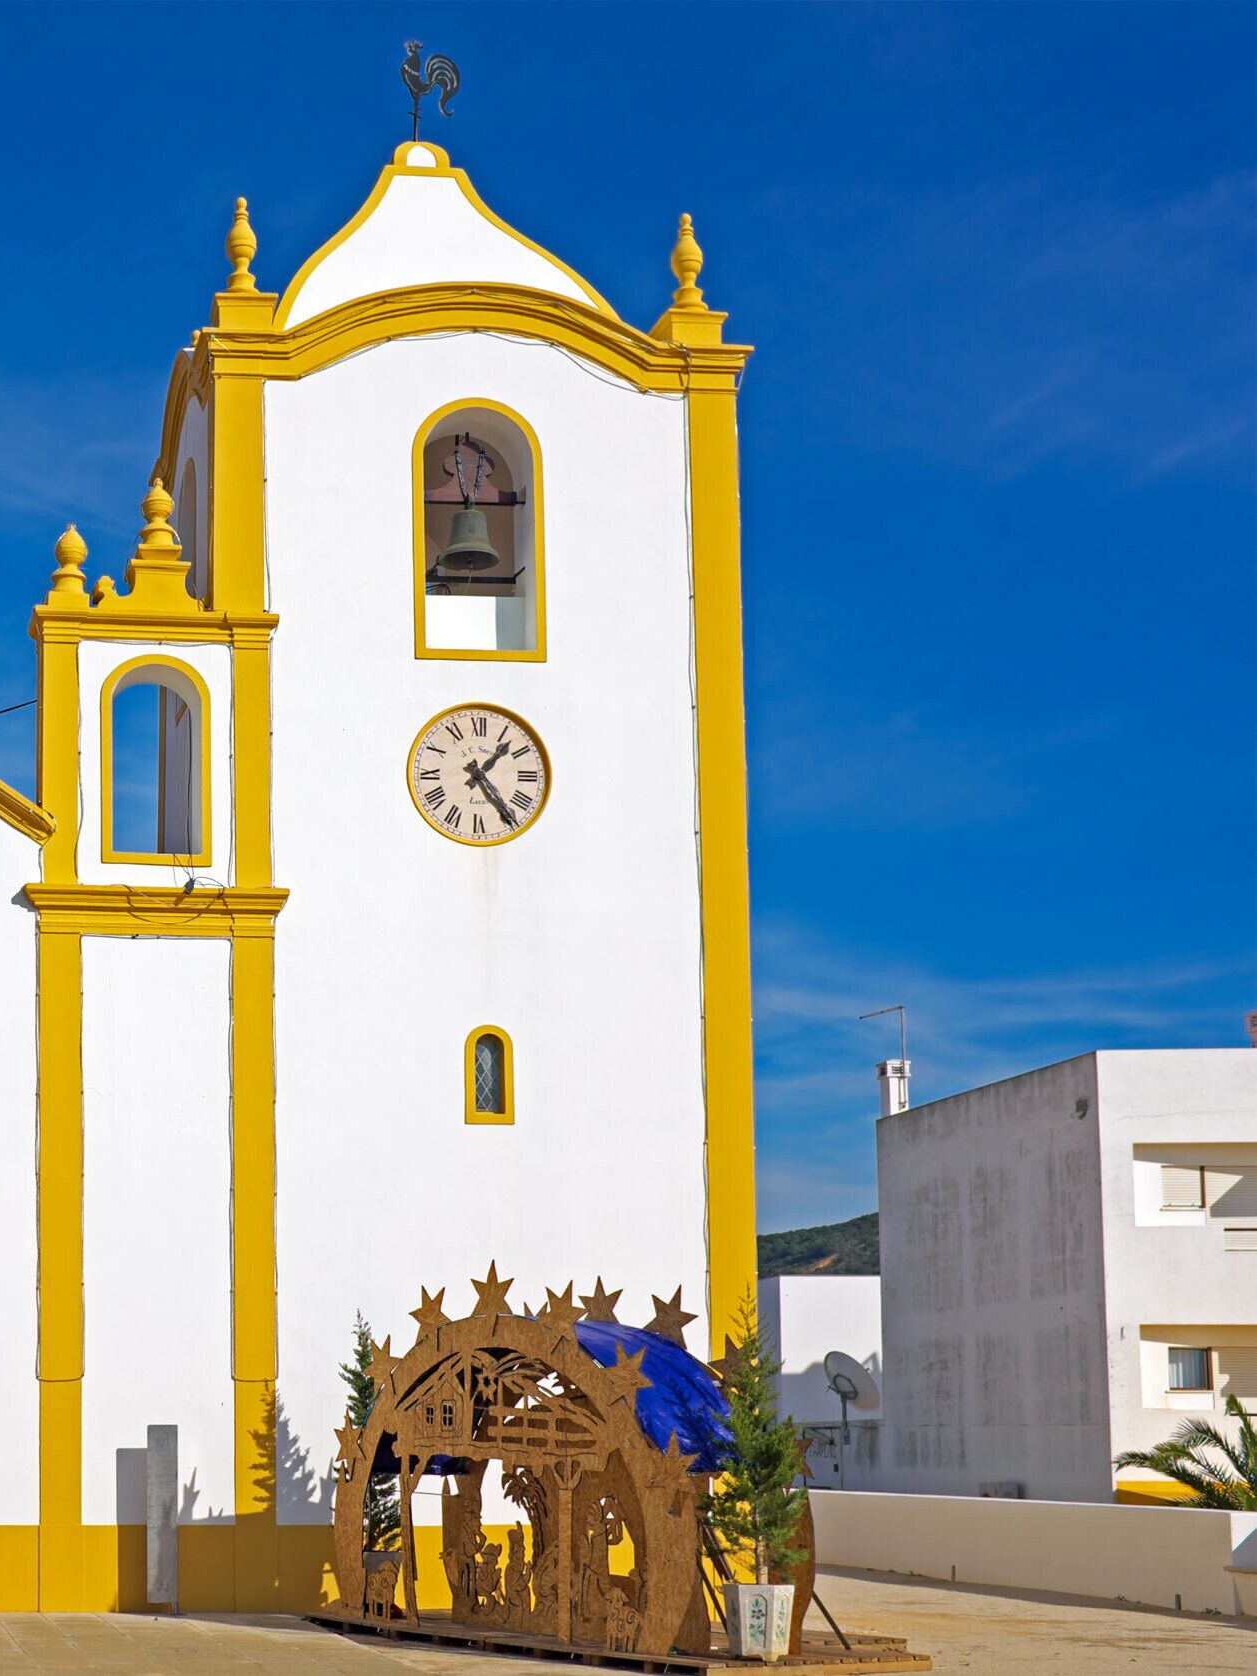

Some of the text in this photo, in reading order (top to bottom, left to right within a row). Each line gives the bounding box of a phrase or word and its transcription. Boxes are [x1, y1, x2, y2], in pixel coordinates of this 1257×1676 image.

[445, 722, 464, 745] XI
[471, 717, 487, 737] XII
[426, 741, 447, 759] X
[420, 767, 441, 781] IX
[517, 770, 538, 782] III
[424, 786, 447, 811] VIII
[444, 804, 463, 828] VII
